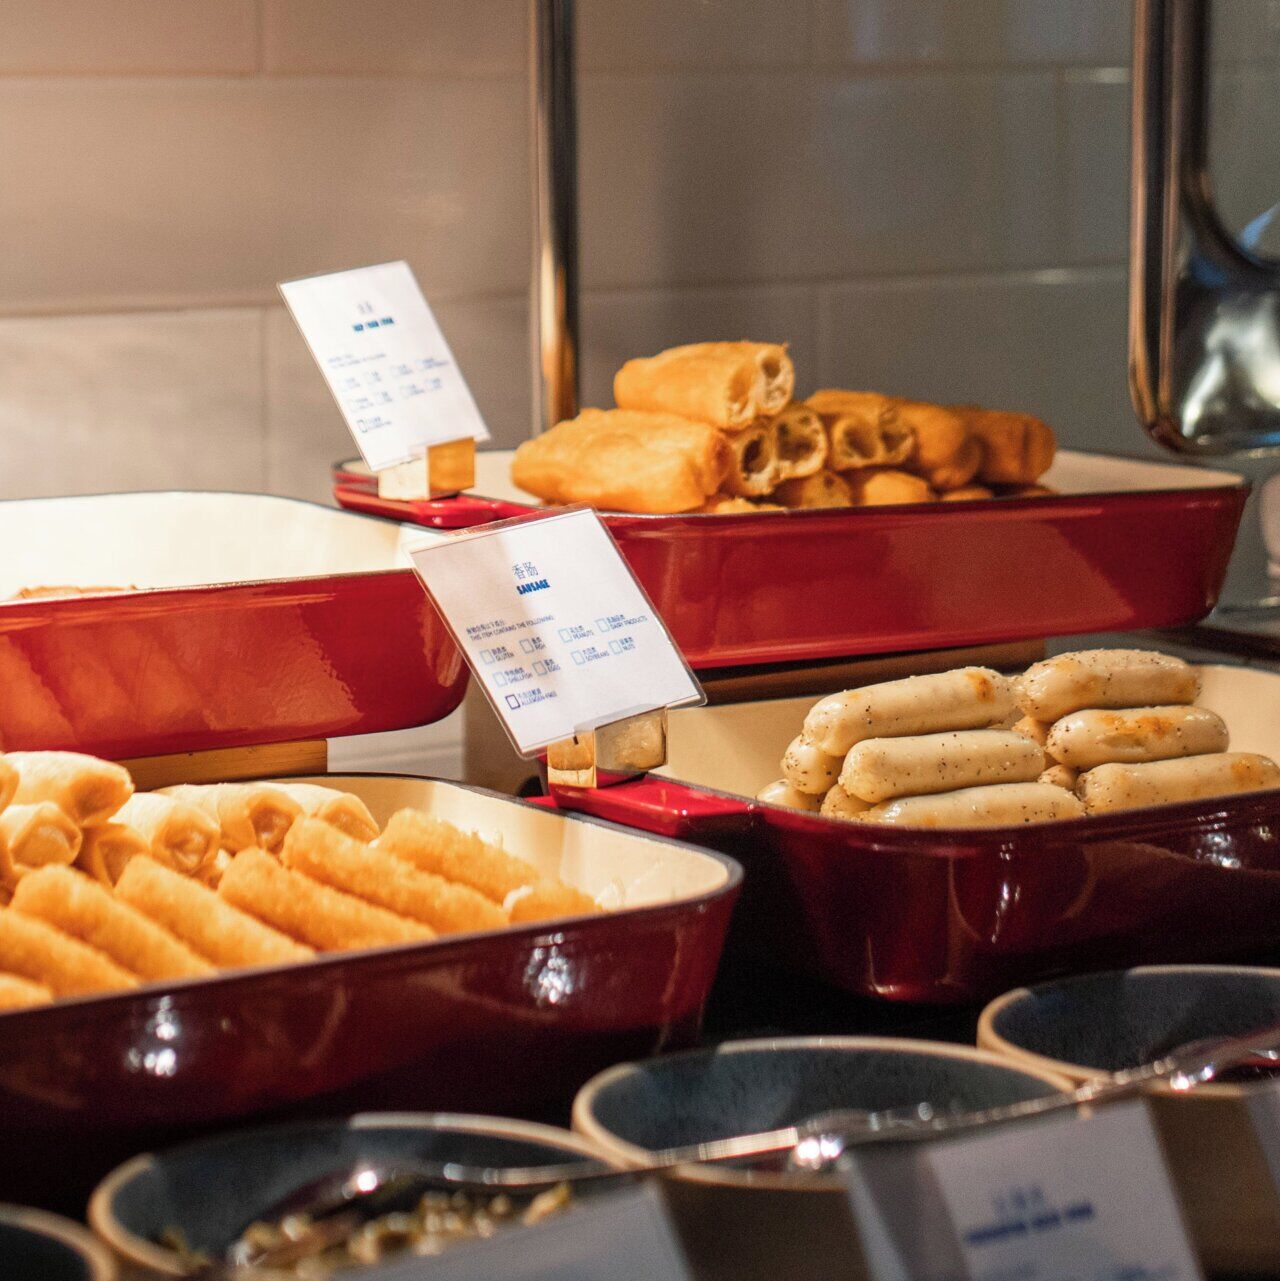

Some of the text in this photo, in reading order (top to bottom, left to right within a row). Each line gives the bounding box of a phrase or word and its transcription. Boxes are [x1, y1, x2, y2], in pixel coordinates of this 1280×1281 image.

[512, 561, 538, 579] 香肠
[516, 579, 550, 595] SAUSAGE
[623, 615, 648, 625] PRODUCTS
[493, 625, 517, 635] CONTAINS
[572, 629, 594, 640] PEANUTS
[495, 651, 515, 662] GLUTEN
[586, 650, 609, 662] SOYBEANS
